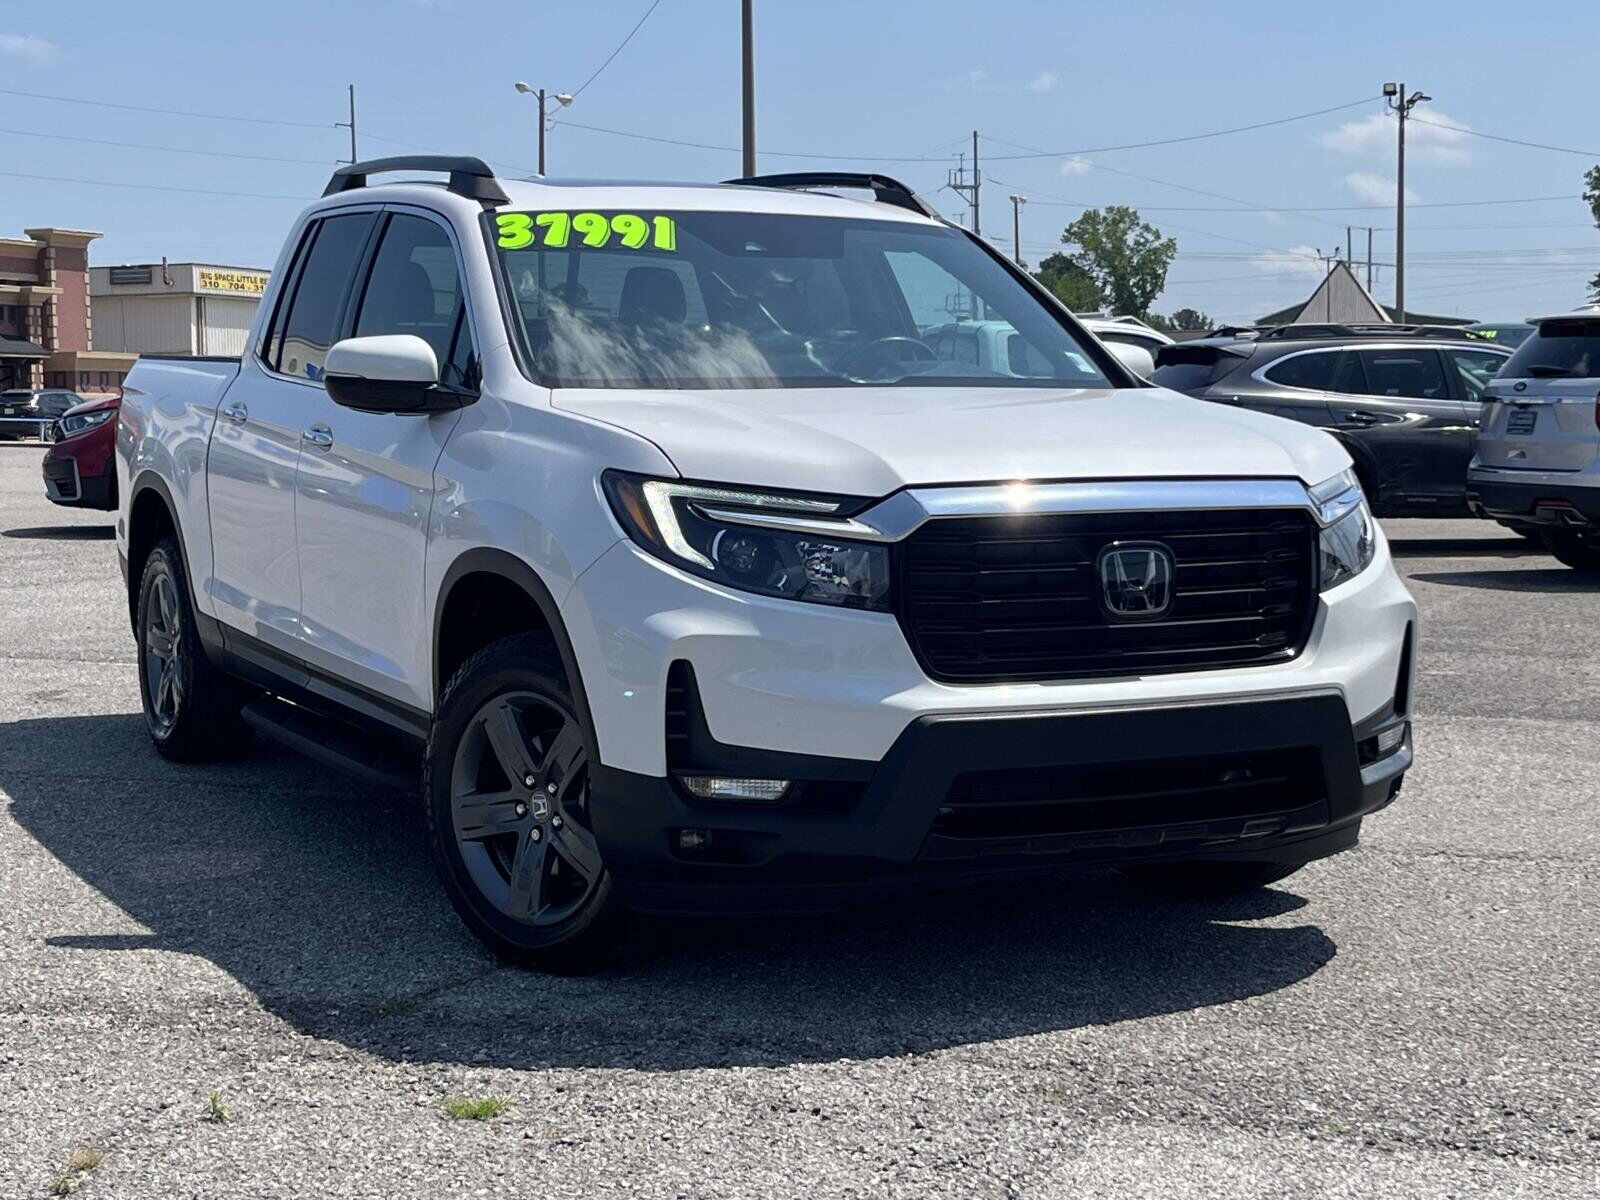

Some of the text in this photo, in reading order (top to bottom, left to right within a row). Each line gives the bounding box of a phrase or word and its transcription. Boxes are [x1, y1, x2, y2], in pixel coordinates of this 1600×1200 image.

[495, 212, 677, 251] 37991
[201, 272, 212, 280] BIG
[214, 273, 235, 282] SPACE
[236, 275, 258, 284] LITTLE
[202, 280, 219, 288] 310
[228, 282, 245, 290] 704
